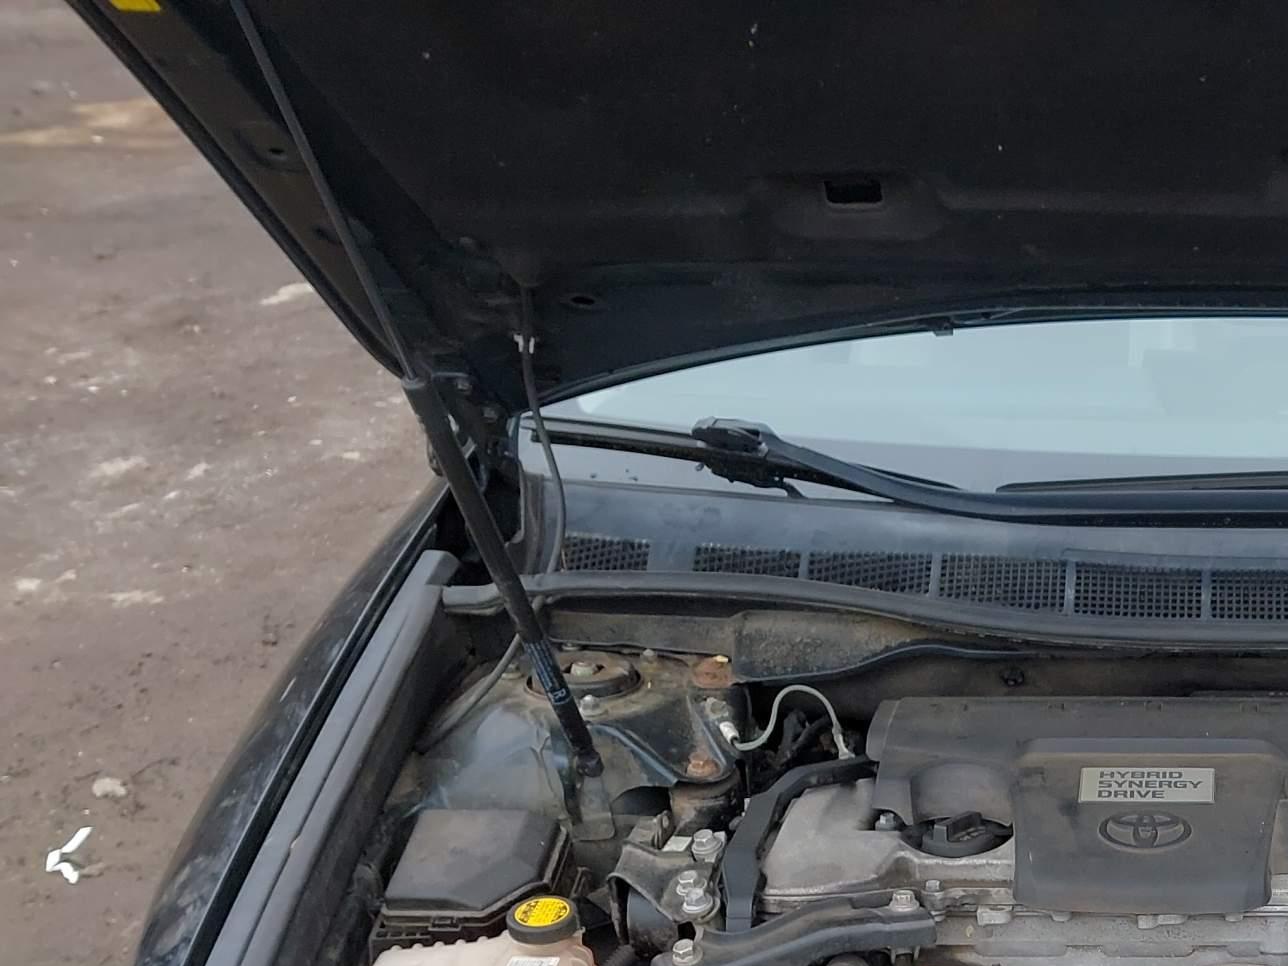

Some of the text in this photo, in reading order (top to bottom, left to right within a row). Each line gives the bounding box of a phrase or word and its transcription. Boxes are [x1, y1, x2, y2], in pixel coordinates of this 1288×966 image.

[1099, 771, 1183, 779] HYBRID
[1098, 780, 1203, 788] SYNERGY
[1098, 789, 1165, 798] DRIVE
